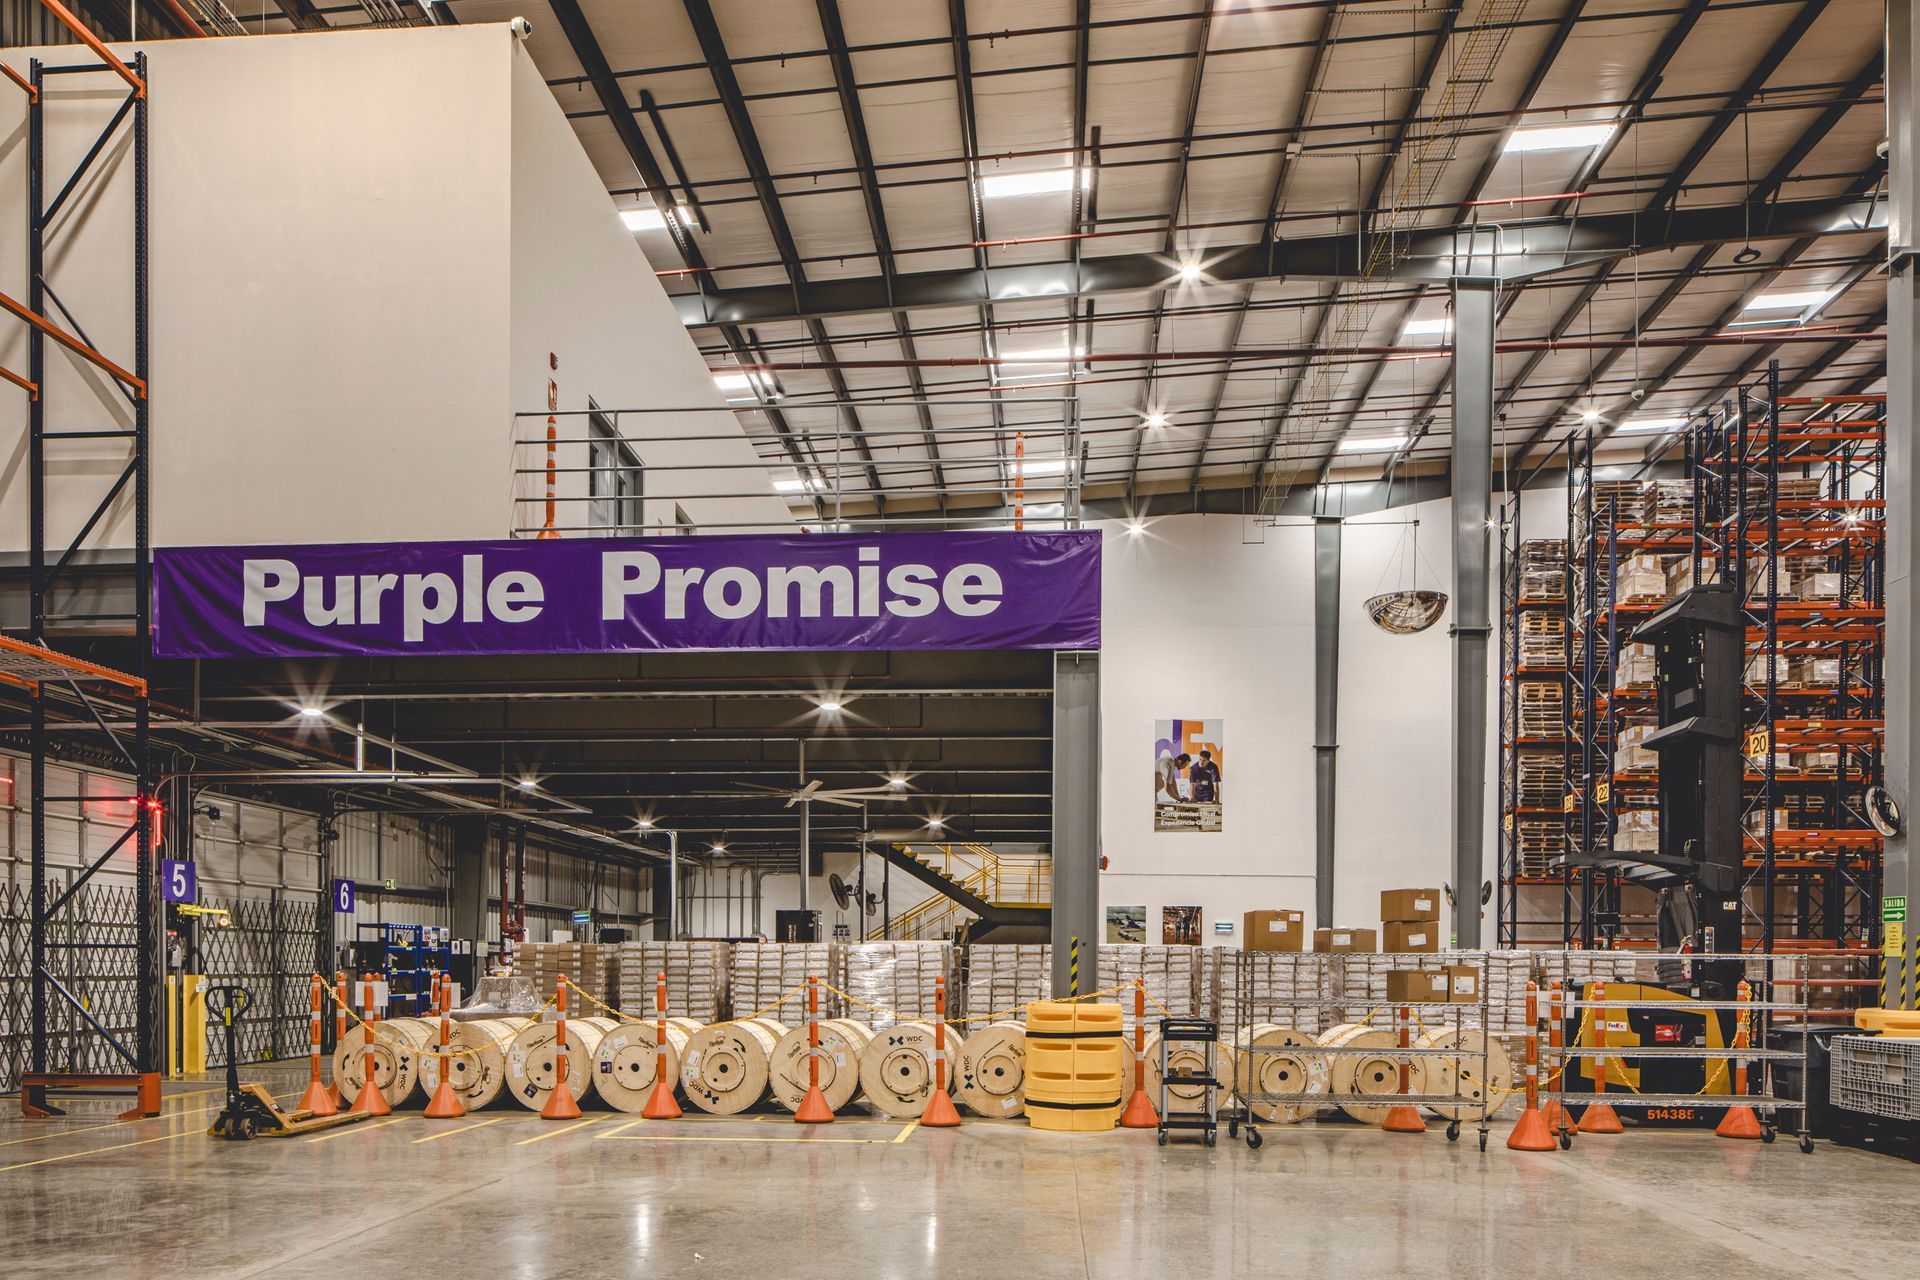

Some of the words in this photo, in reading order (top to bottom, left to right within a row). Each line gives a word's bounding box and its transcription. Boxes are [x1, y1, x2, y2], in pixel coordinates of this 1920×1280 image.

[243, 553, 545, 642] Purple
[602, 546, 1003, 621] Promise
[1752, 735, 1767, 755] 20
[1598, 785, 1608, 801] 22
[172, 863, 186, 898] 5
[340, 882, 349, 910] 6
[1884, 898, 1905, 908] SALIDA
[1723, 901, 1737, 910] CAT
[399, 1073, 407, 1090] WDC
[689, 1080, 704, 1094] WDC
